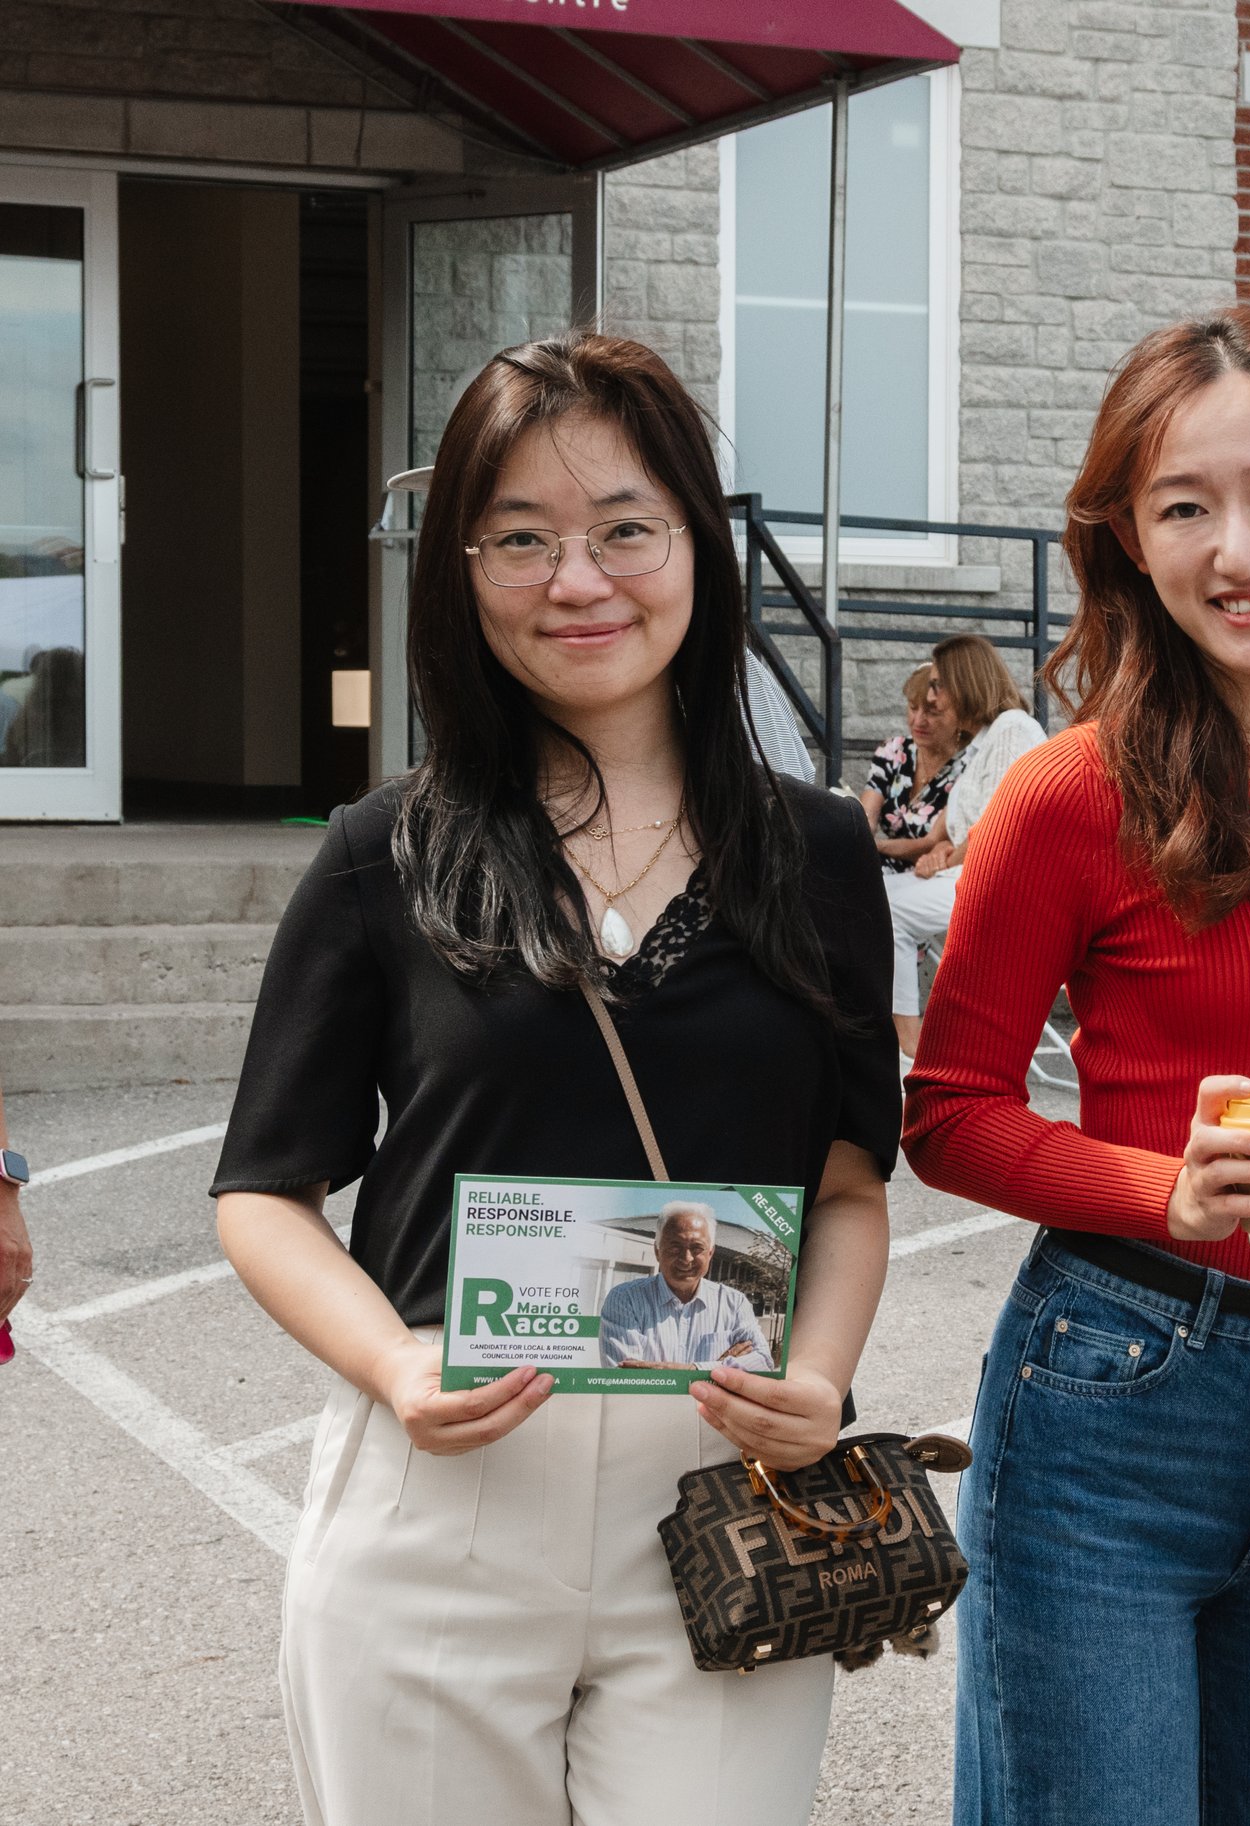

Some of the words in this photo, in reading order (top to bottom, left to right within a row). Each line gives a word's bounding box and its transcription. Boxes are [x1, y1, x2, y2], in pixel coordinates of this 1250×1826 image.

[468, 1191, 544, 1206] RELIABLE.
[467, 1207, 577, 1223] RESPONSIBLE.
[751, 1192, 796, 1236] RE-ELECT
[466, 1223, 567, 1238] RESPONSIVE.
[519, 1287, 551, 1298] VOTE
[555, 1287, 580, 1298] FOR
[517, 1302, 561, 1315] Mario
[567, 1303, 582, 1315] G.
[587, 1377, 677, 1386] VOTE@MARIOGRACCO.CA
[818, 1561, 878, 1590] ROMA
